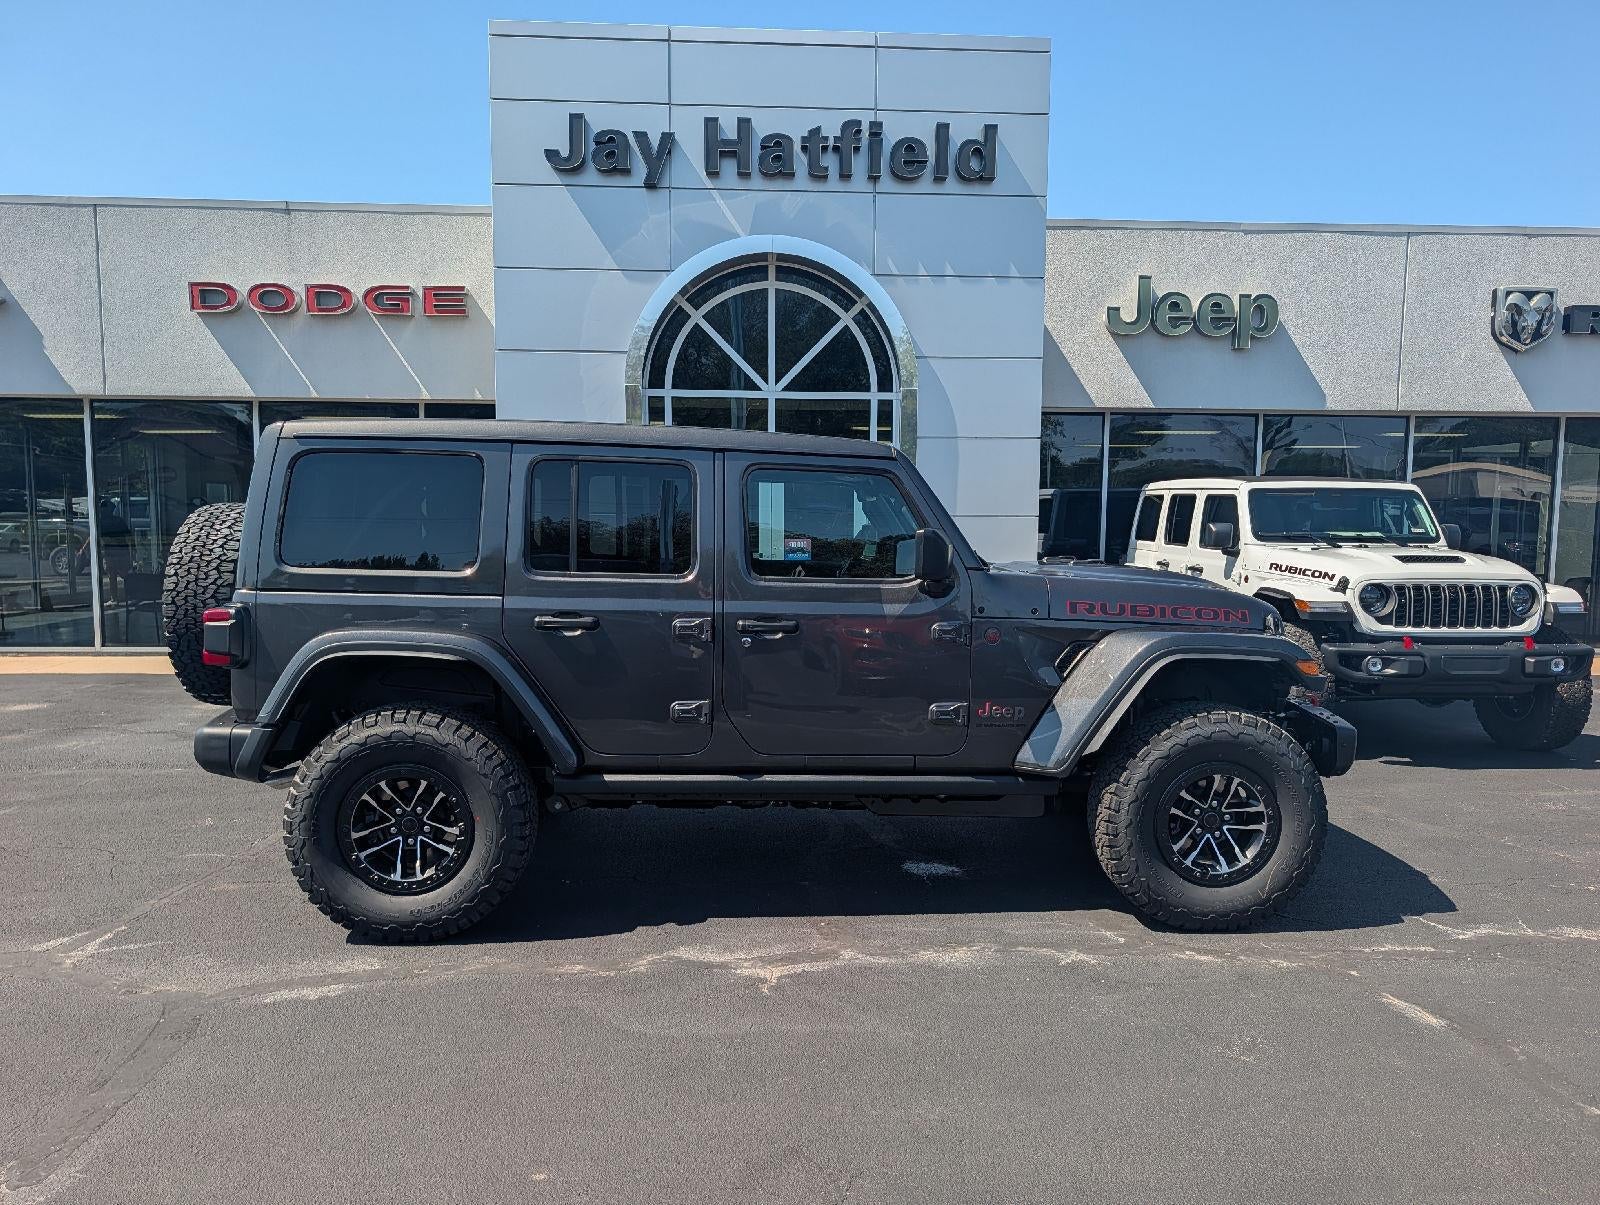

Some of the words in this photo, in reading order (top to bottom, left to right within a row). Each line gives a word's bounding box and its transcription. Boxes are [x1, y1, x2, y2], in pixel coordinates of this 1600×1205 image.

[543, 112, 675, 188] Jay
[704, 116, 999, 183] Hatfield
[189, 282, 468, 317] DODGE
[1105, 274, 1280, 350] Jeep
[1269, 562, 1337, 582] RUBICON
[1067, 601, 1250, 622] RUBICON
[976, 701, 1025, 721] Jeep
